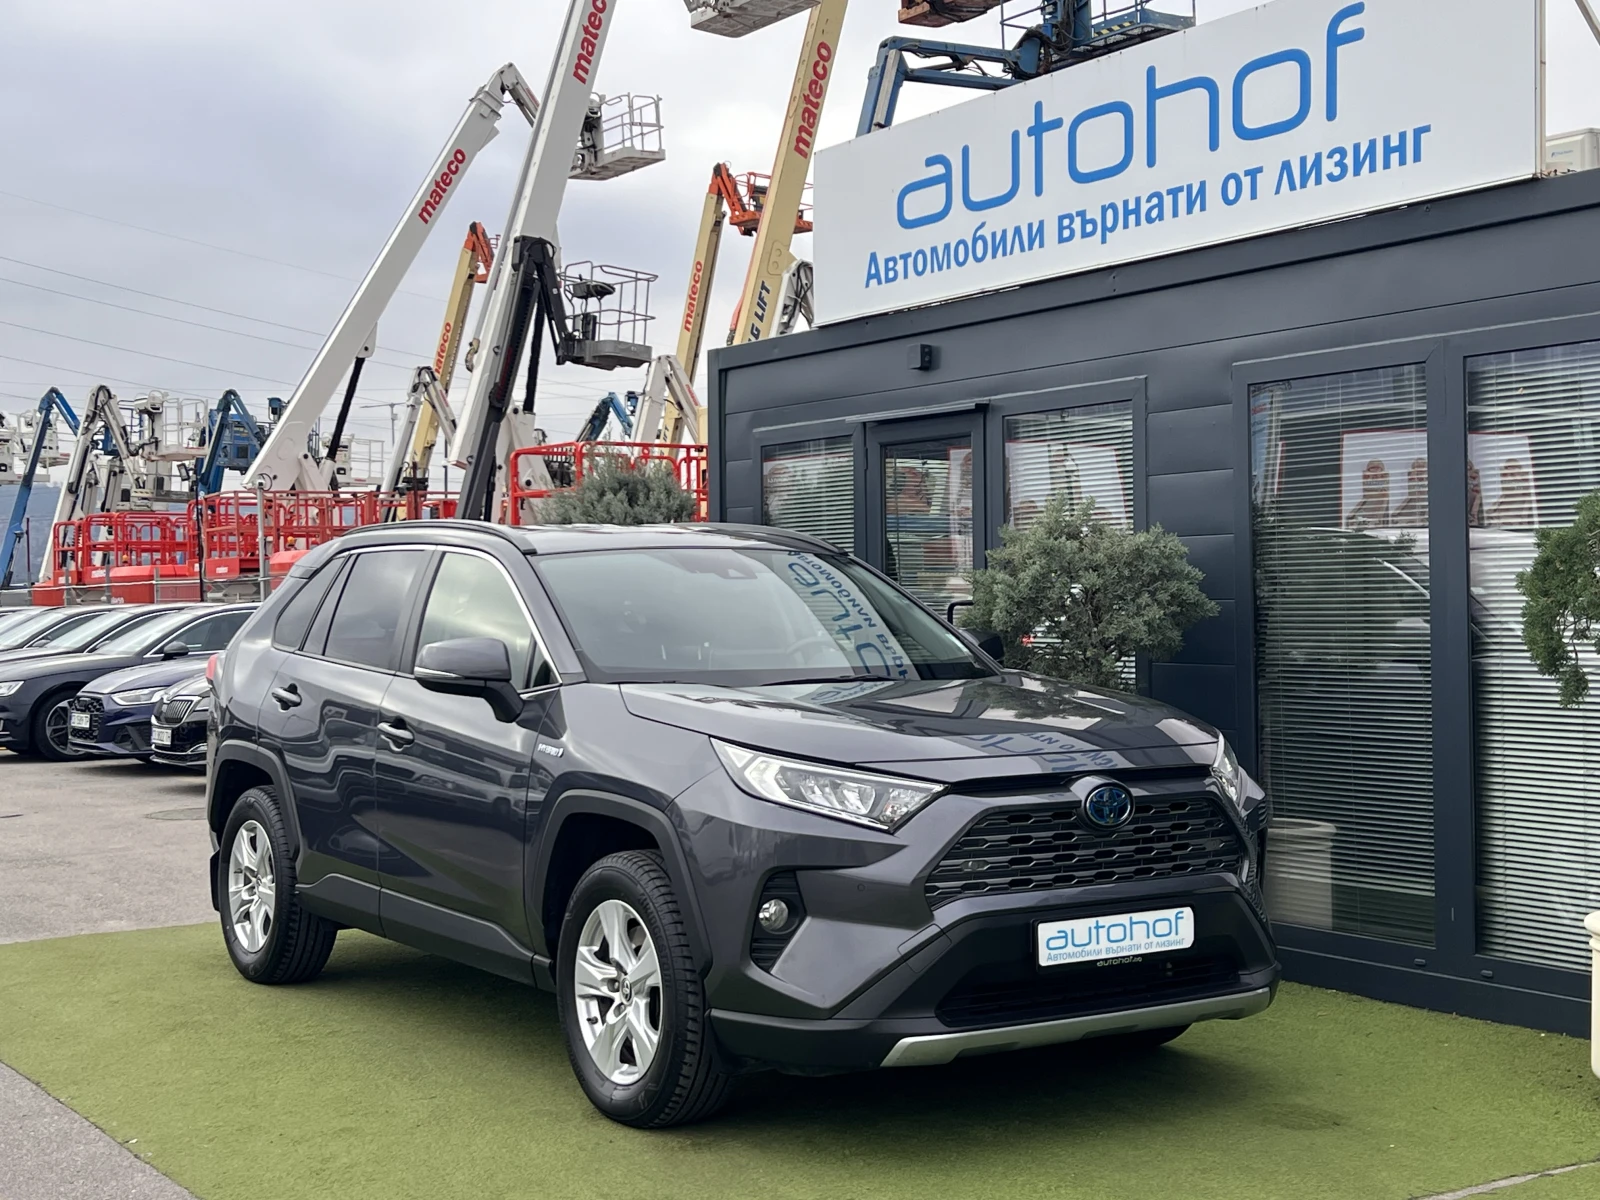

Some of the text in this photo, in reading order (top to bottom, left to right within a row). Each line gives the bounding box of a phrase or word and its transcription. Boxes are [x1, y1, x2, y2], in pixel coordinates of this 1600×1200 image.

[794, 41, 832, 159] mateco
[897, 1, 1365, 229] autohof
[418, 149, 466, 224] mateco
[865, 124, 1431, 288] Автомобили върнати от лизинг
[684, 261, 702, 333] mateco
[748, 280, 770, 341] G LIFT
[1046, 911, 1184, 951] autohof
[1046, 938, 1186, 962] Автомобили върнати от лизинг
